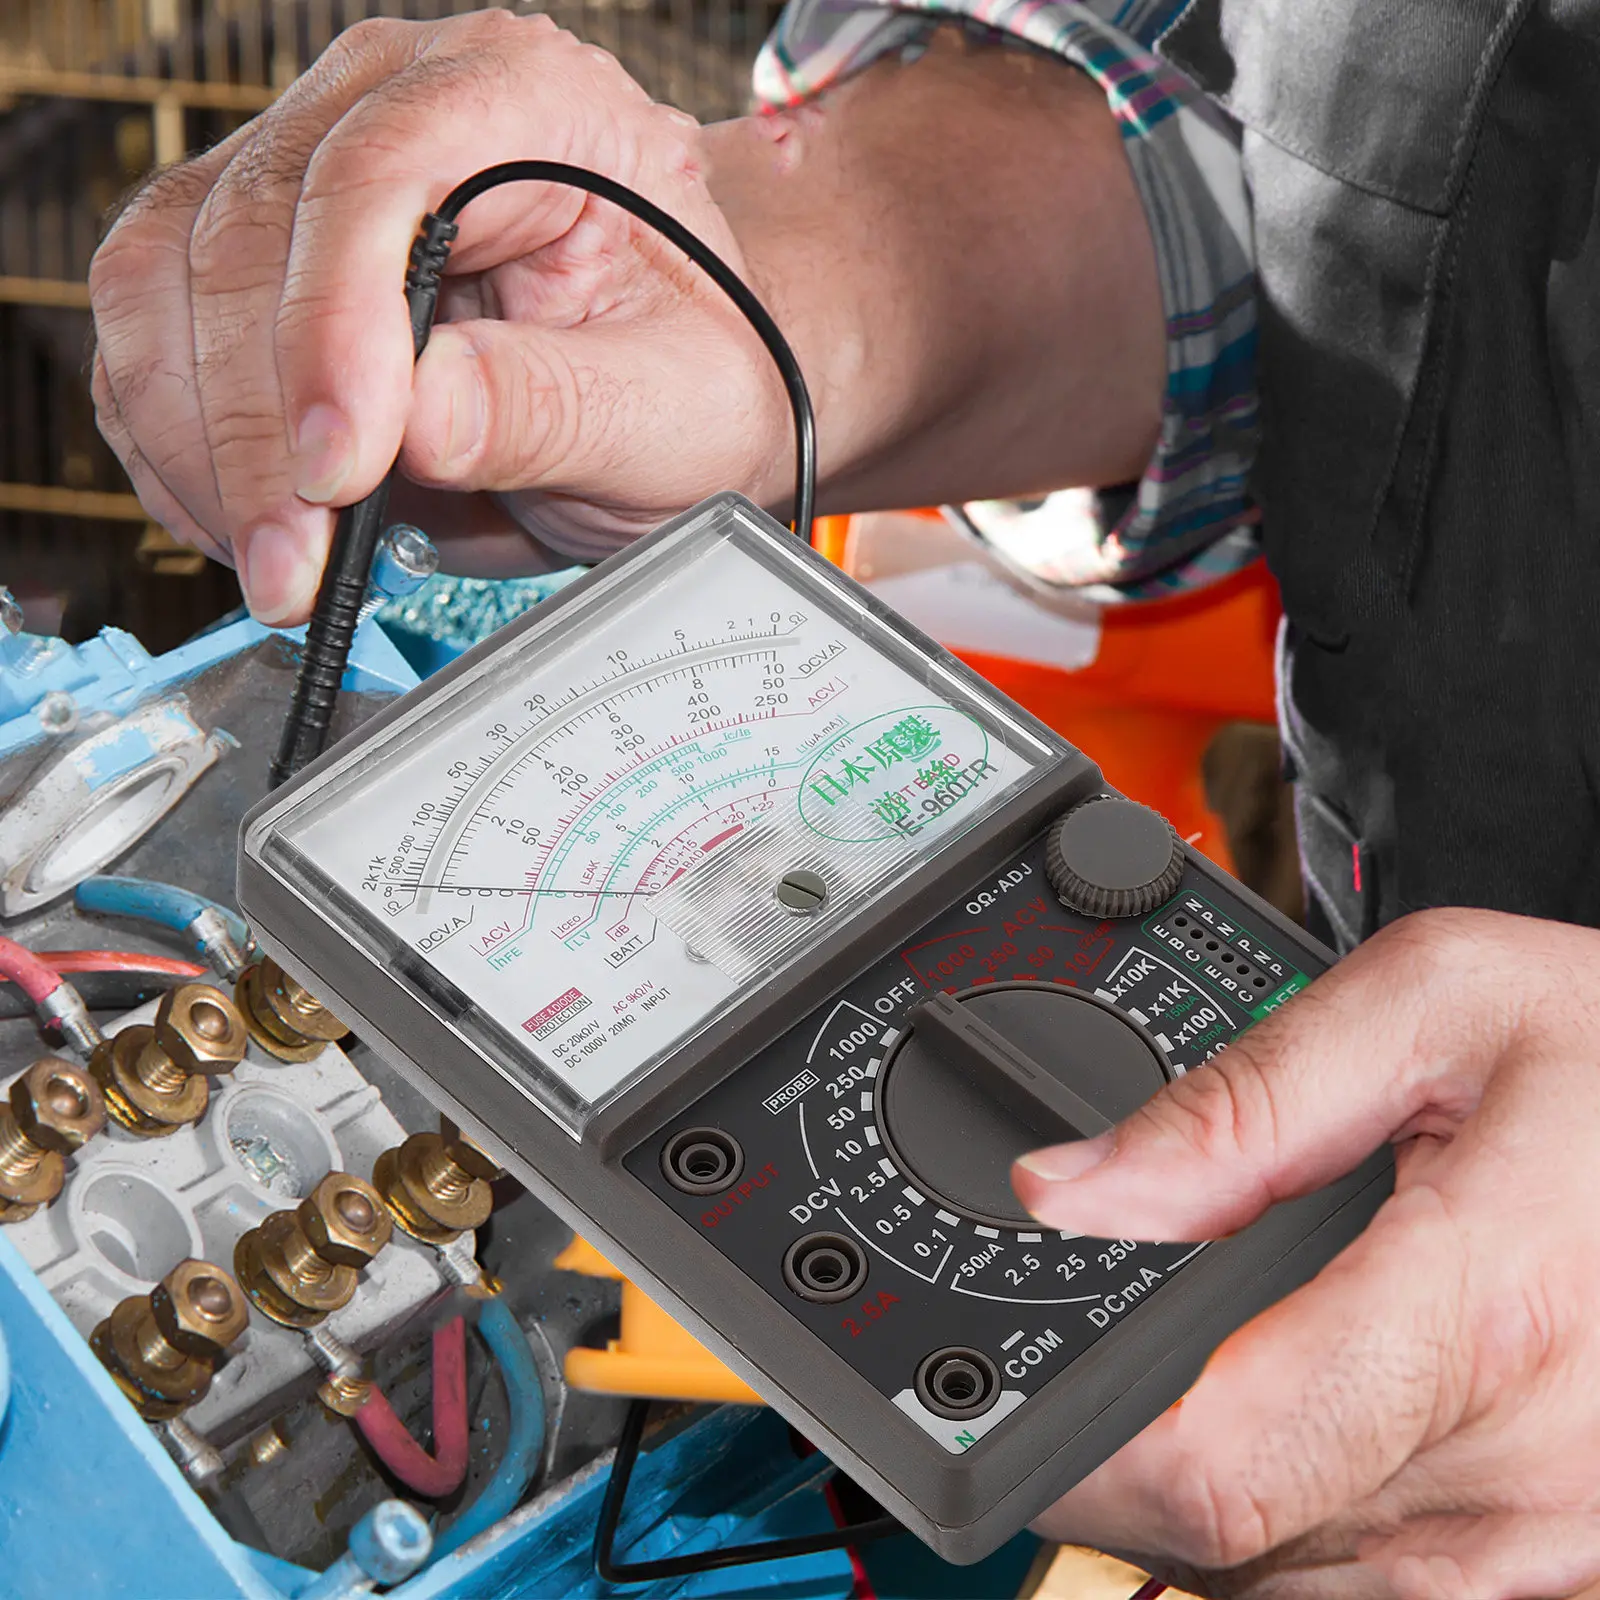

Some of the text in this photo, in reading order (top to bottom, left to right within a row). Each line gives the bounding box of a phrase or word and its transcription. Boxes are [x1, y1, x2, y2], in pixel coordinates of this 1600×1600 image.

[674, 629, 686, 641] 5
[726, 620, 736, 630] 2
[607, 649, 628, 665] 10
[798, 641, 842, 675] DCV.A
[762, 663, 785, 675] 10
[692, 678, 704, 689] 8
[762, 677, 785, 690] 50
[523, 693, 546, 711] 20
[687, 692, 709, 707] 40
[754, 692, 789, 707] 250
[807, 681, 836, 707] ACV
[608, 712, 621, 723] 6
[687, 705, 722, 724] 200
[486, 723, 508, 741] 30
[610, 723, 633, 740] 30
[614, 733, 646, 757] 150
[764, 746, 781, 756] 15
[542, 759, 556, 770] 4
[696, 747, 728, 765] 1000
[446, 761, 468, 779] 50
[552, 765, 574, 784] 20
[671, 760, 695, 777] 500
[560, 773, 589, 797] 100
[635, 779, 659, 798] 200
[678, 773, 695, 785] 10
[411, 802, 436, 828] 100
[606, 803, 627, 821] 100
[750, 800, 775, 812] +22
[490, 816, 507, 827] 2
[506, 819, 525, 835] 10
[721, 810, 745, 825] +20
[522, 826, 544, 847] 50
[585, 830, 601, 845] 50
[615, 823, 627, 833] 5
[397, 834, 416, 854] 200
[650, 839, 663, 849] 2
[678, 839, 698, 857] +15
[388, 855, 405, 875] 500
[661, 857, 679, 877] +10
[682, 849, 705, 869] BAD
[580, 859, 601, 885] LEAK
[1002, 895, 1048, 939] ACV
[417, 916, 466, 951] DCV.A
[481, 920, 512, 948] ACV
[613, 924, 630, 938] dB
[494, 947, 523, 968] hFE
[610, 934, 644, 962] BATT
[980, 941, 1018, 973] 250
[1027, 945, 1054, 968] 50
[928, 944, 976, 982] 1000
[1064, 952, 1091, 974] 10
[874, 977, 916, 1013] OFF
[535, 996, 589, 1038] PROTECTION
[612, 1000, 628, 1015] AC
[526, 1011, 551, 1031] FUSE
[564, 1054, 582, 1069] DC
[580, 1033, 608, 1057] 1000V
[640, 987, 672, 1012] INPUT
[552, 1044, 570, 1058] DC
[829, 1022, 878, 1061] 1000
[768, 1073, 815, 1110] PROBE
[825, 1065, 866, 1099] 250
[826, 1106, 856, 1130] 50
[835, 1139, 863, 1163] 10
[701, 1161, 782, 1229] OUTPUT
[850, 1171, 886, 1203] 2.5
[788, 1177, 842, 1225] DCV
[875, 1204, 912, 1235] 0.5
[913, 1228, 949, 1258] 0.1
[1097, 1238, 1138, 1271] 250
[1004, 1253, 1041, 1287] 2.5
[1055, 1253, 1087, 1281] 25
[1086, 1267, 1163, 1329] DCmA
[841, 1290, 901, 1338] 2.5A
[1004, 1328, 1064, 1379] COM
[954, 1429, 977, 1449] N
